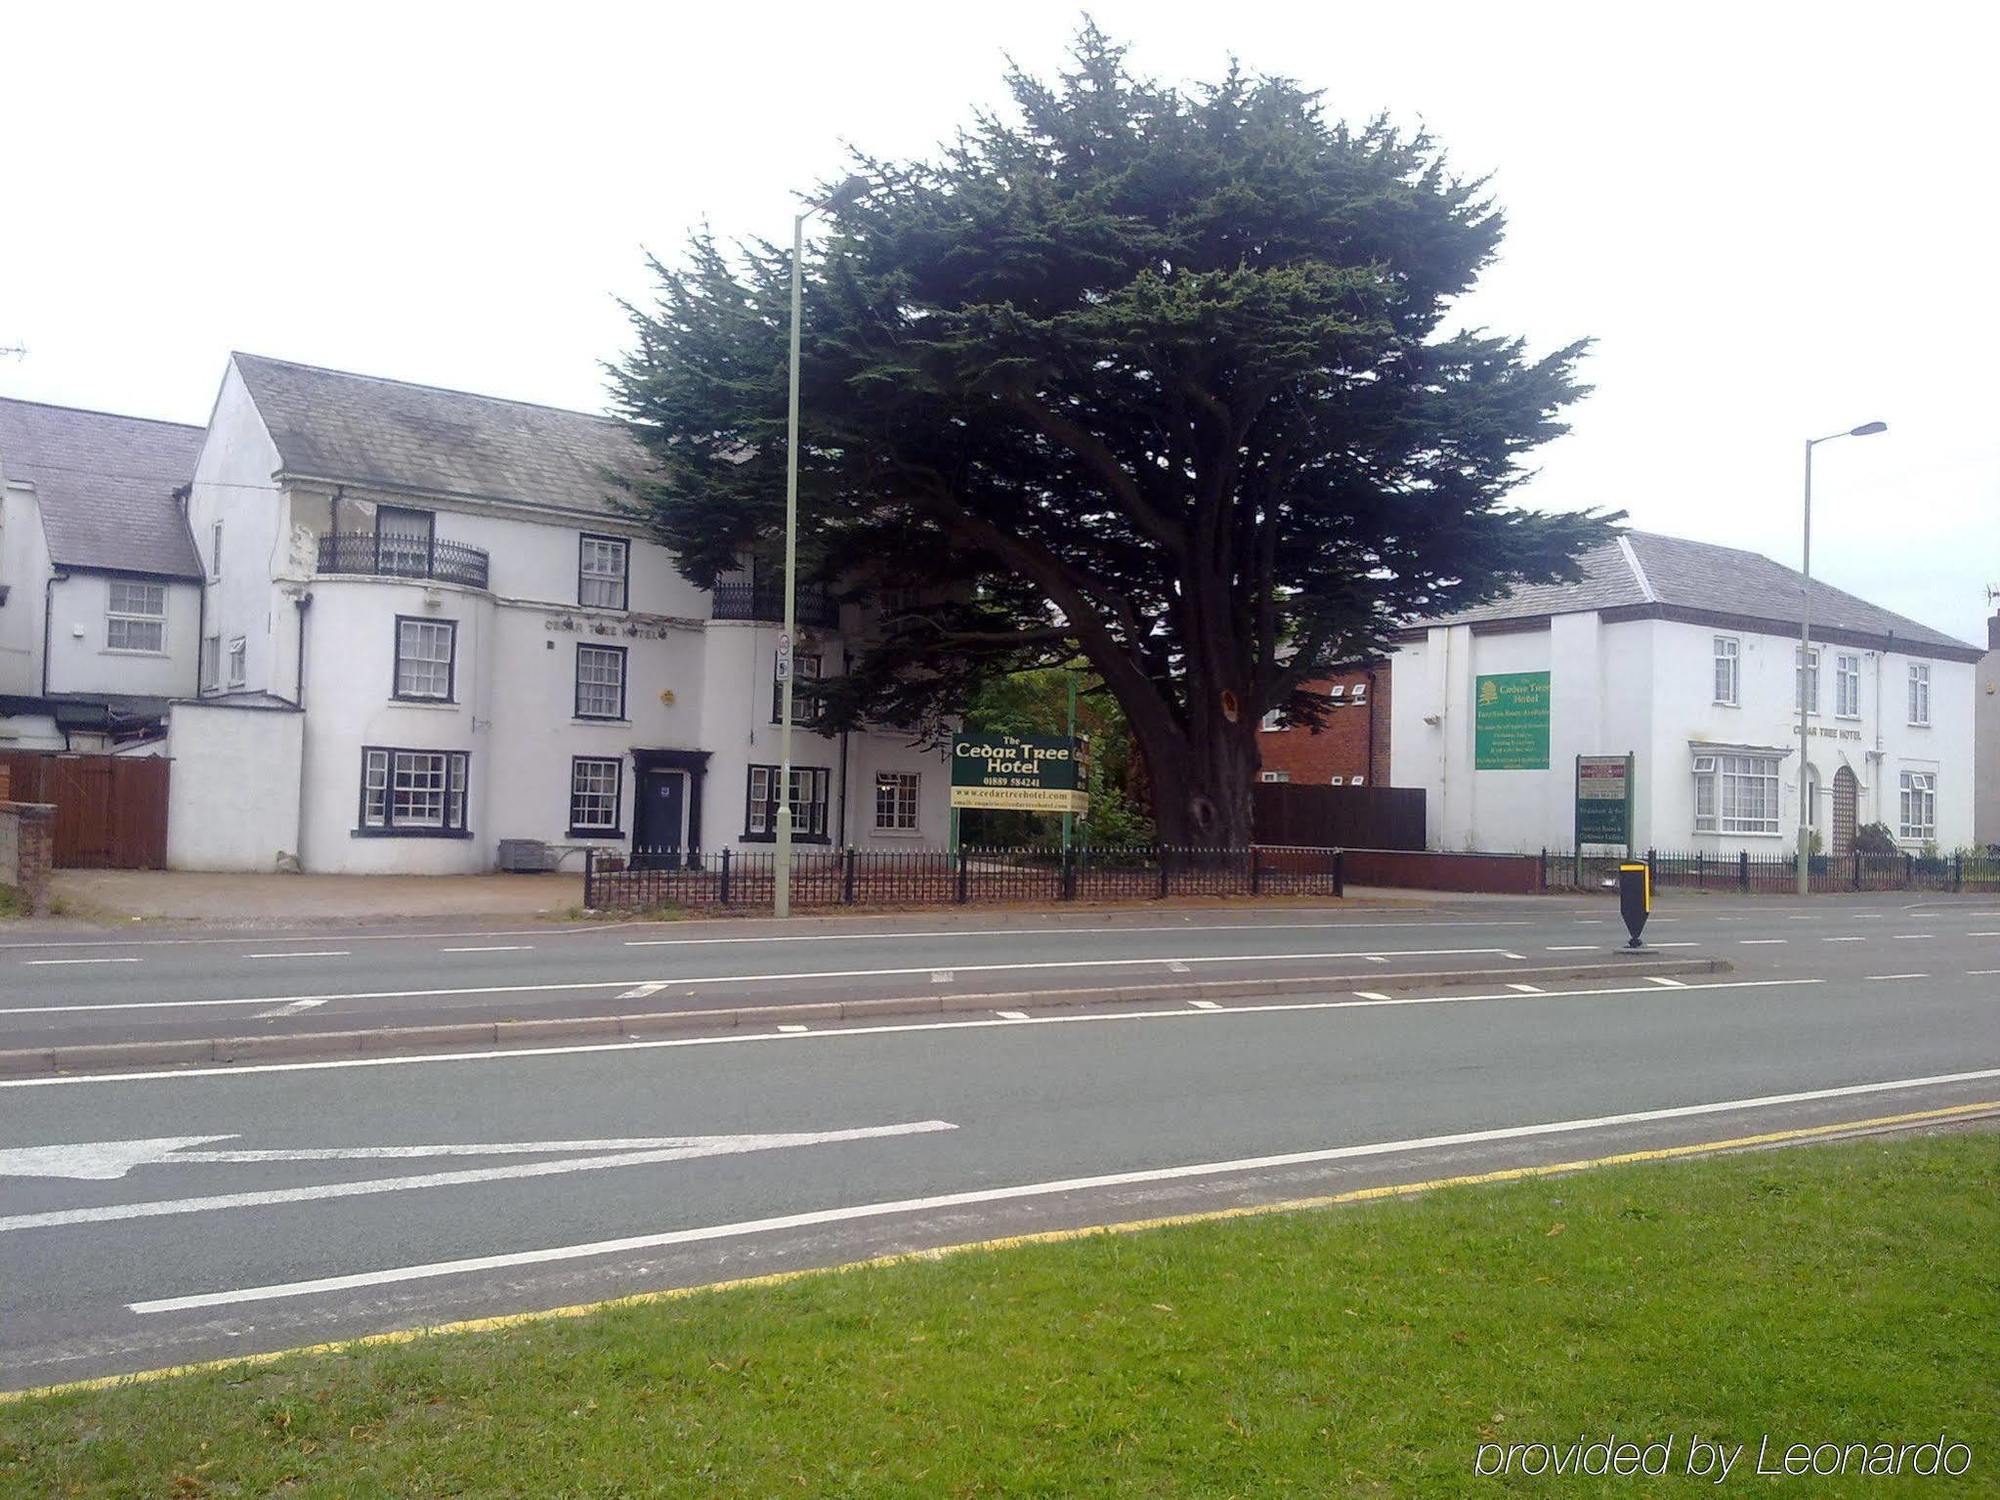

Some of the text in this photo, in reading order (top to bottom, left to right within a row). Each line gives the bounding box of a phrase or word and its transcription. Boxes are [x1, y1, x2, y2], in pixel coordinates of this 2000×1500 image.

[544, 620, 658, 640] CER TEE HTEL
[1003, 736, 1020, 745] The
[1839, 729, 1862, 741] HOTEL
[956, 743, 1069, 760] Cedar Tree
[987, 758, 1040, 774] Hotel
[983, 777, 1007, 786] 01889
[956, 789, 1068, 801] www.cedartreehotel.com
